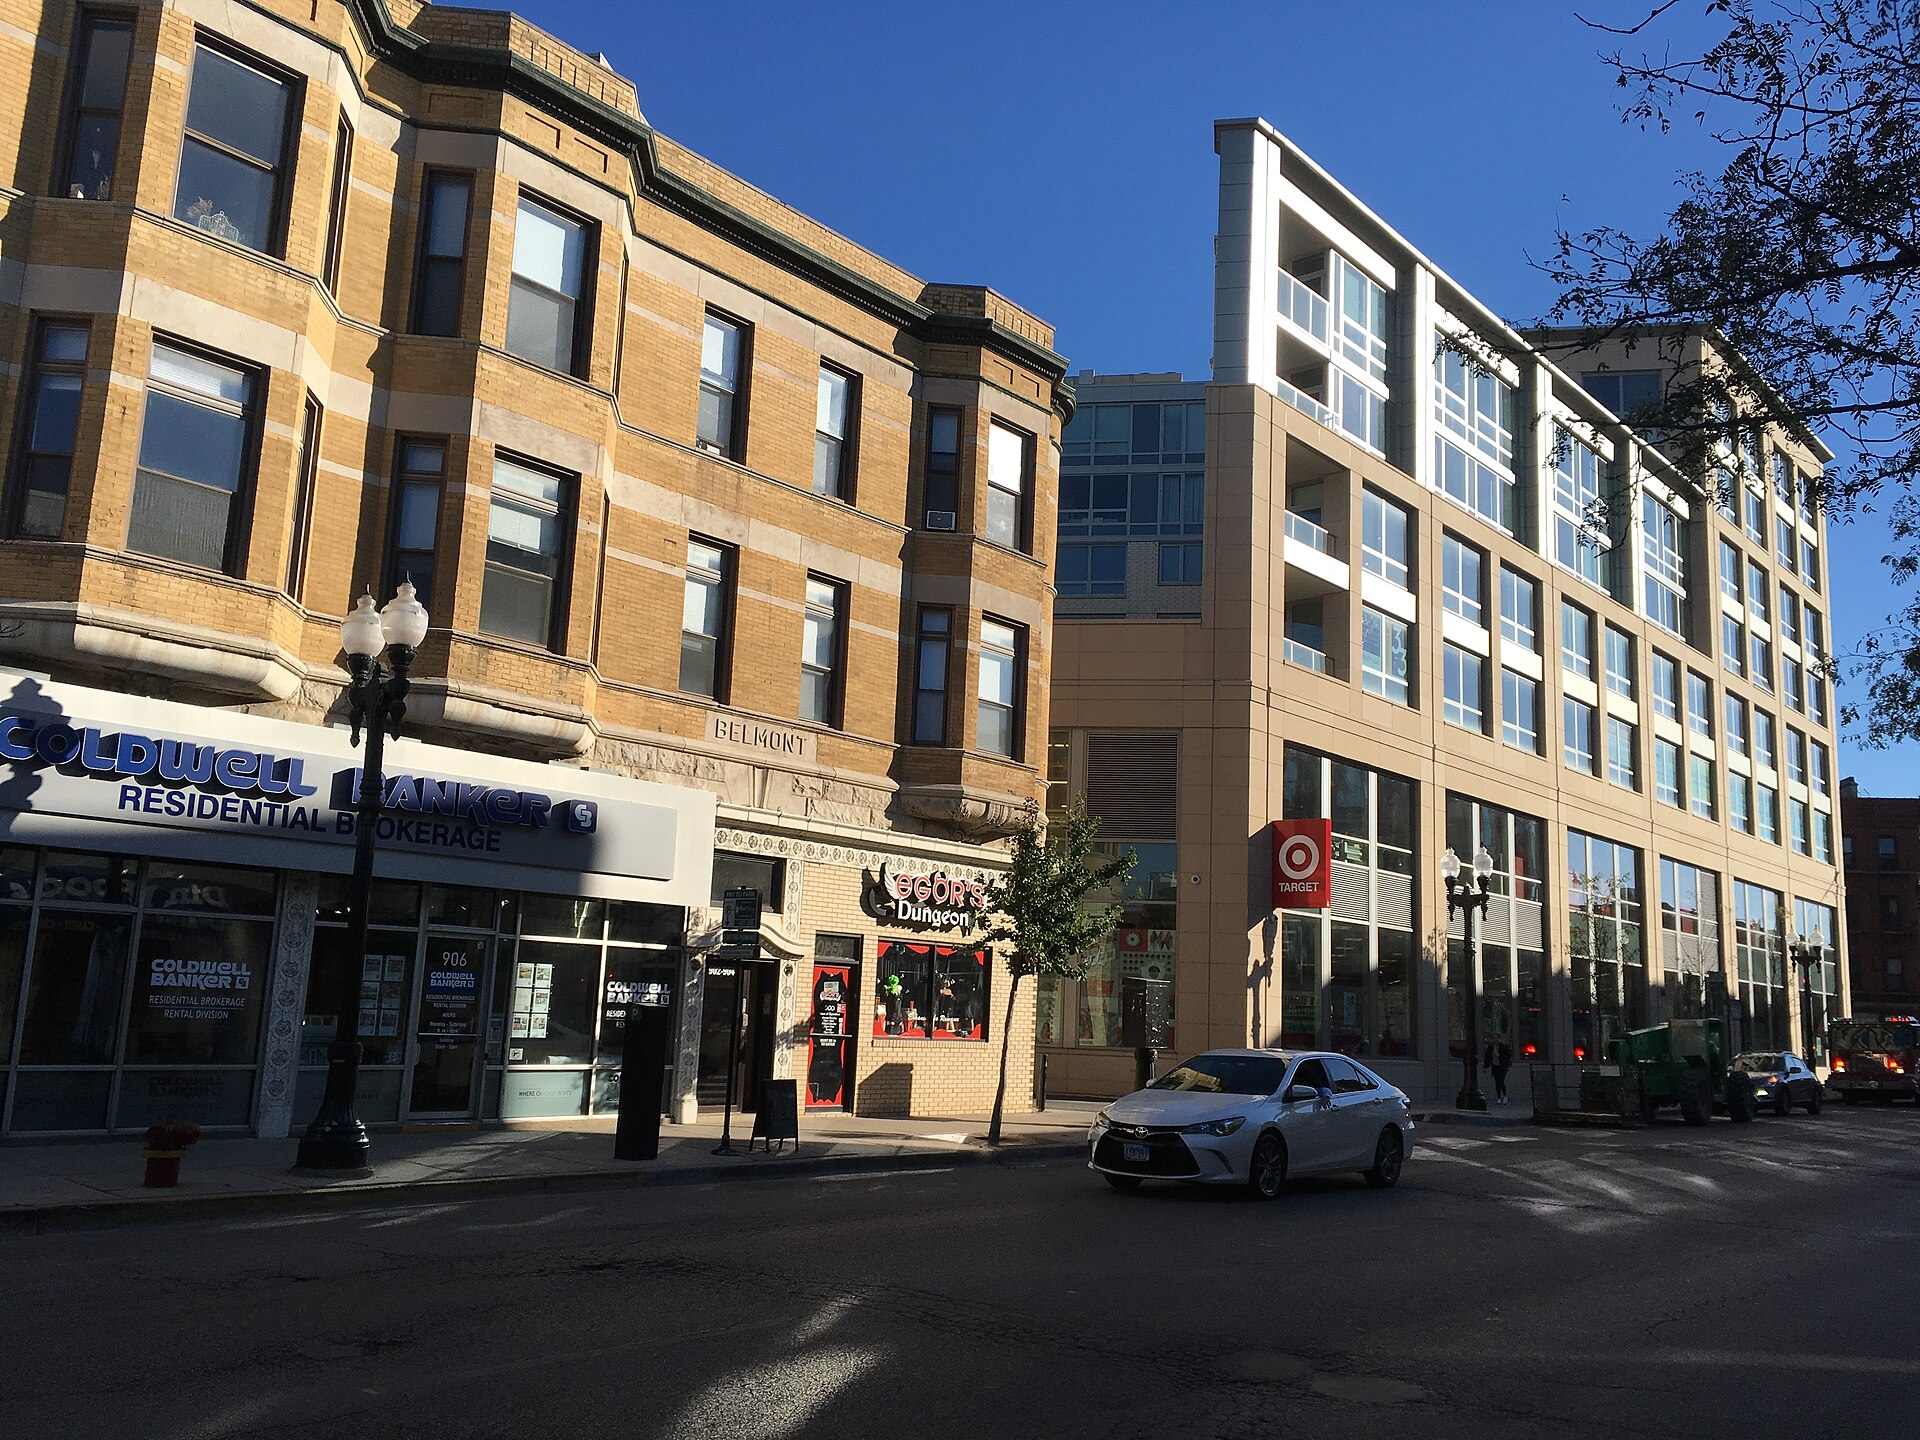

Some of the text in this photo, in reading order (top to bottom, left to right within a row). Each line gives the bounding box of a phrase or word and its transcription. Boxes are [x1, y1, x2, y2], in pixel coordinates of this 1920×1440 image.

[714, 718, 807, 755] BELMONT
[118, 785, 500, 851] RESIDENTIAL BOKERAGE
[1278, 881, 1320, 893] TARGET
[898, 901, 969, 927] Dungeon
[442, 951, 467, 967] 906
[148, 994, 246, 1007] RESIDENTIAL BROKERAGE
[164, 1009, 229, 1020] RENTAL DIVISION
